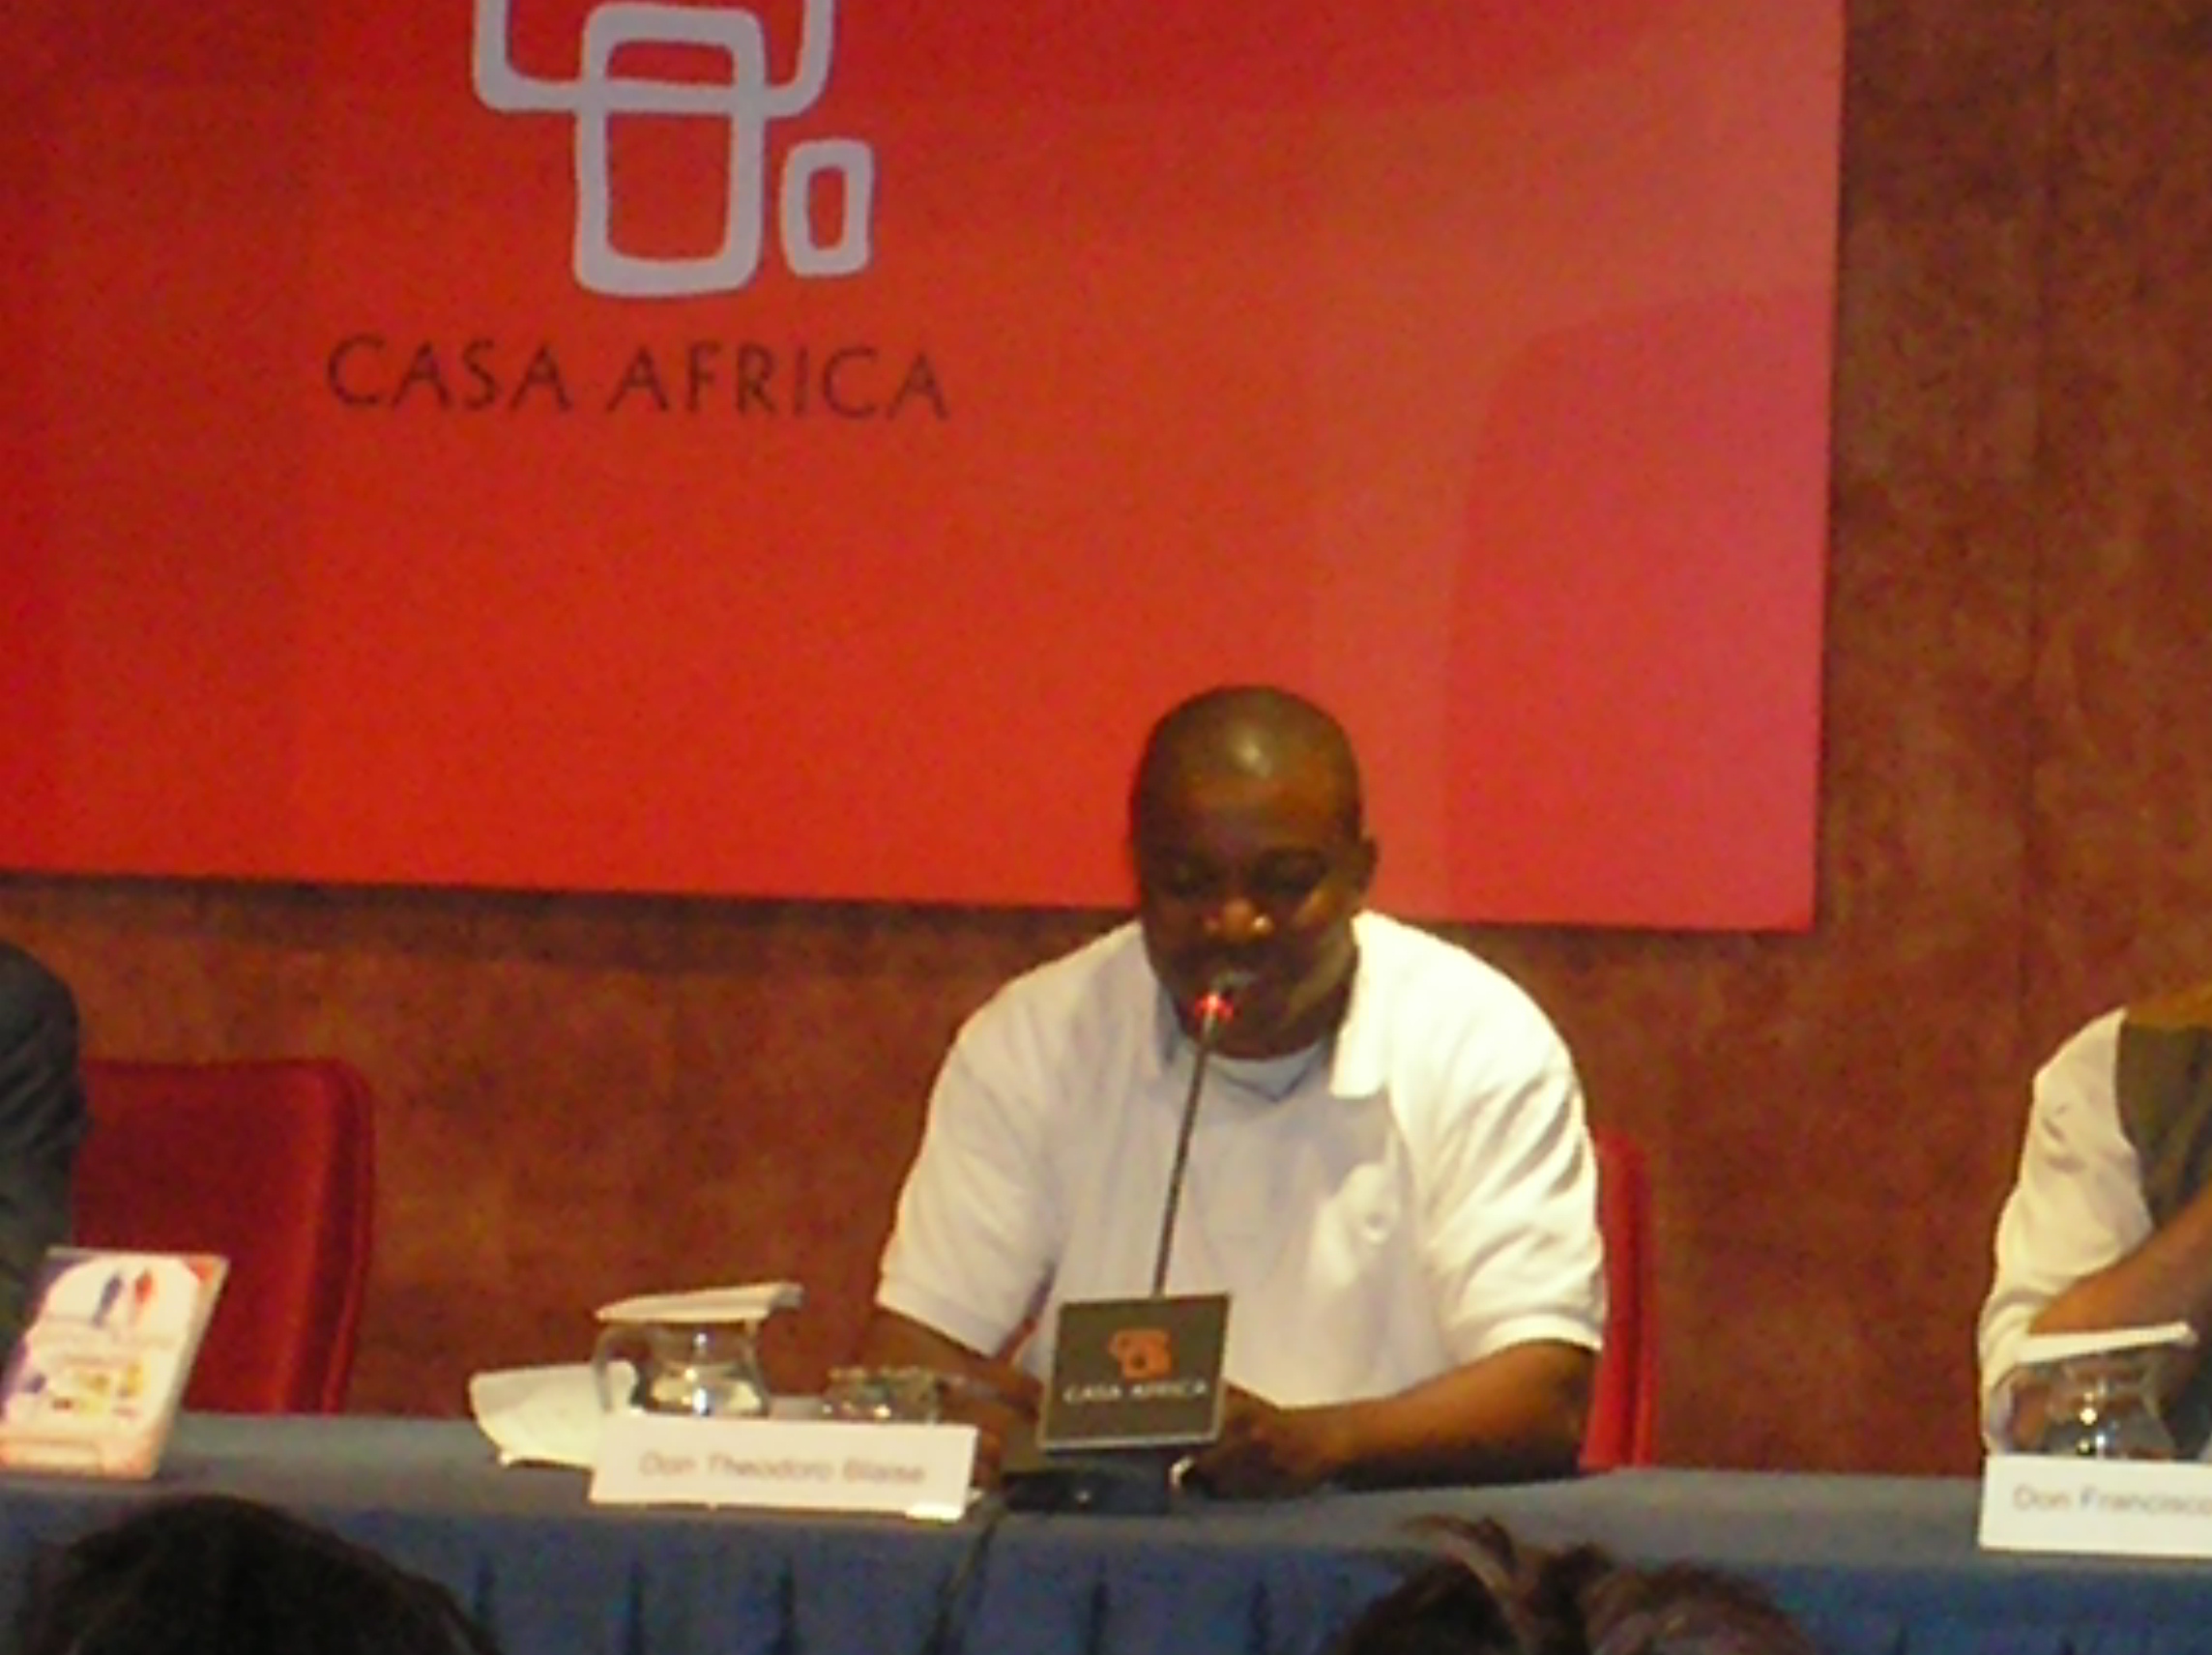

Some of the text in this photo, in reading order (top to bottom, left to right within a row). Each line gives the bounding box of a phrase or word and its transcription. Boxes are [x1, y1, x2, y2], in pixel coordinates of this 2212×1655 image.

[326, 333, 951, 421] CASA AFRICA
[638, 1448, 697, 1479] Don
[2013, 1482, 2071, 1513] Don
